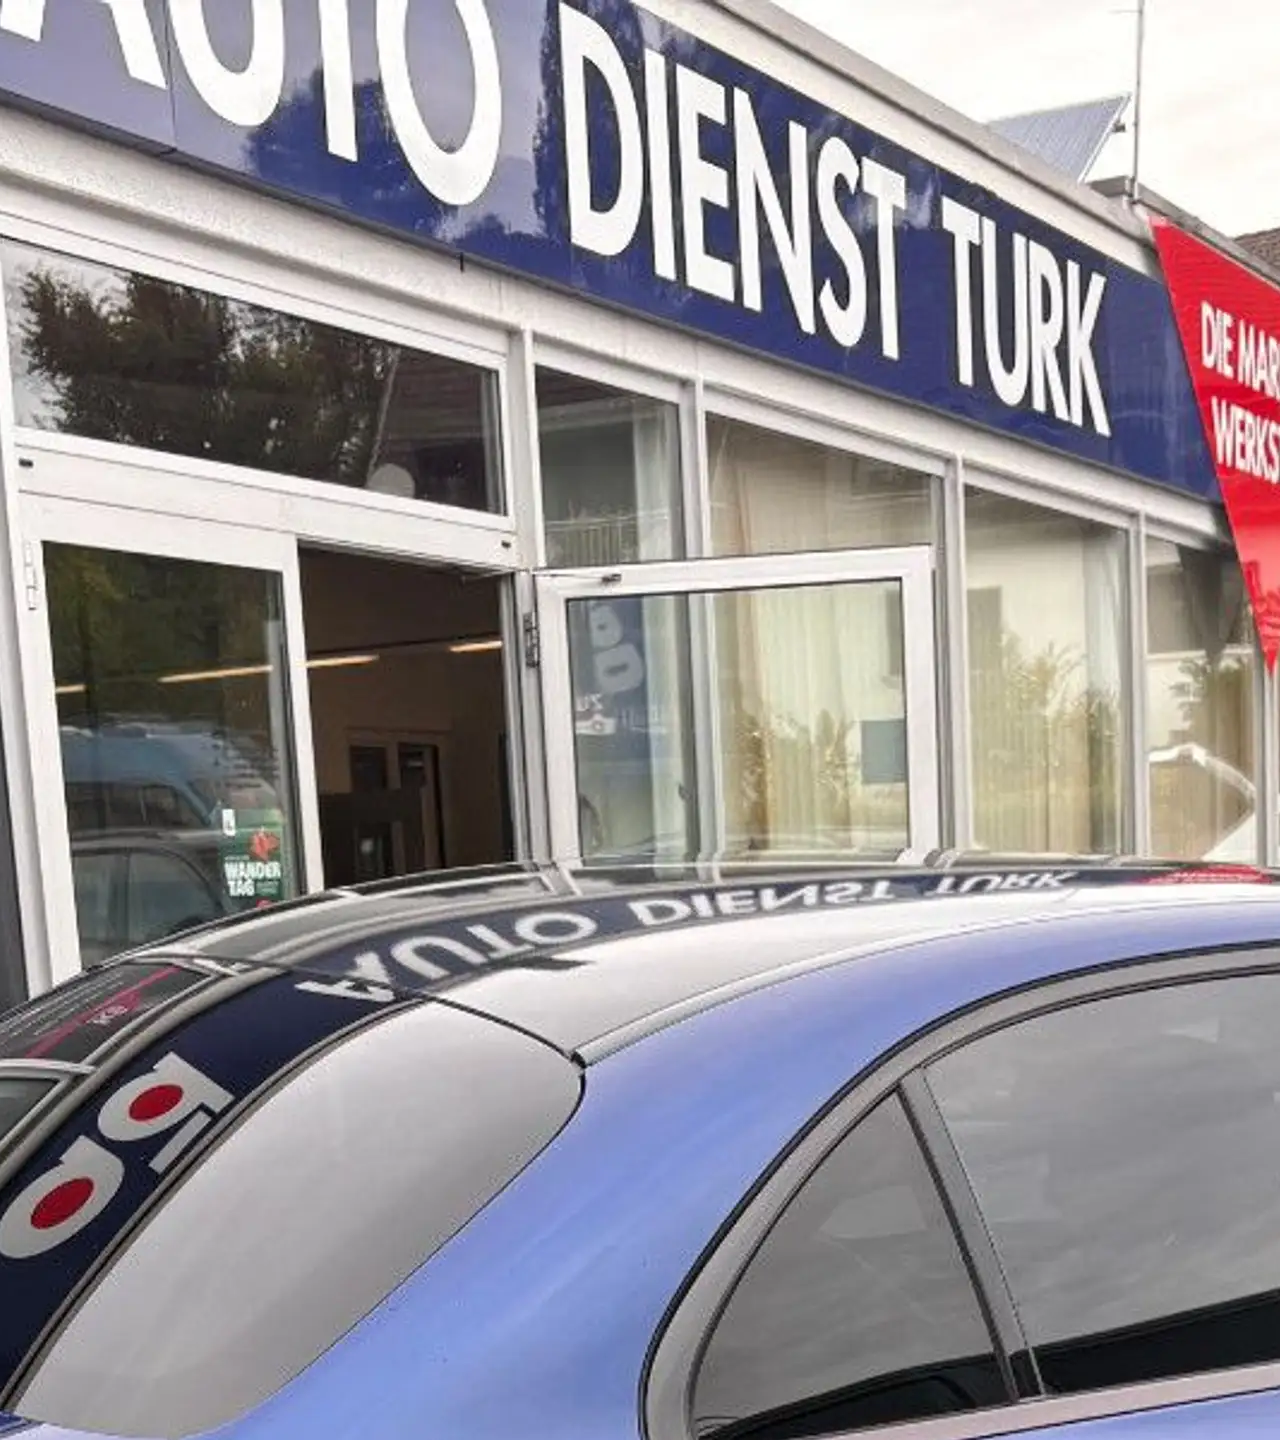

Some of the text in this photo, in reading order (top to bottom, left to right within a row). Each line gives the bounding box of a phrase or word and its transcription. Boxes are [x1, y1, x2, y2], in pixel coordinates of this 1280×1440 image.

[558, 2, 908, 361] DIENST
[941, 195, 1113, 437] TURK
[1201, 300, 1235, 379] DIE
[224, 860, 281, 881] WANDER
[227, 880, 255, 897] TAG
